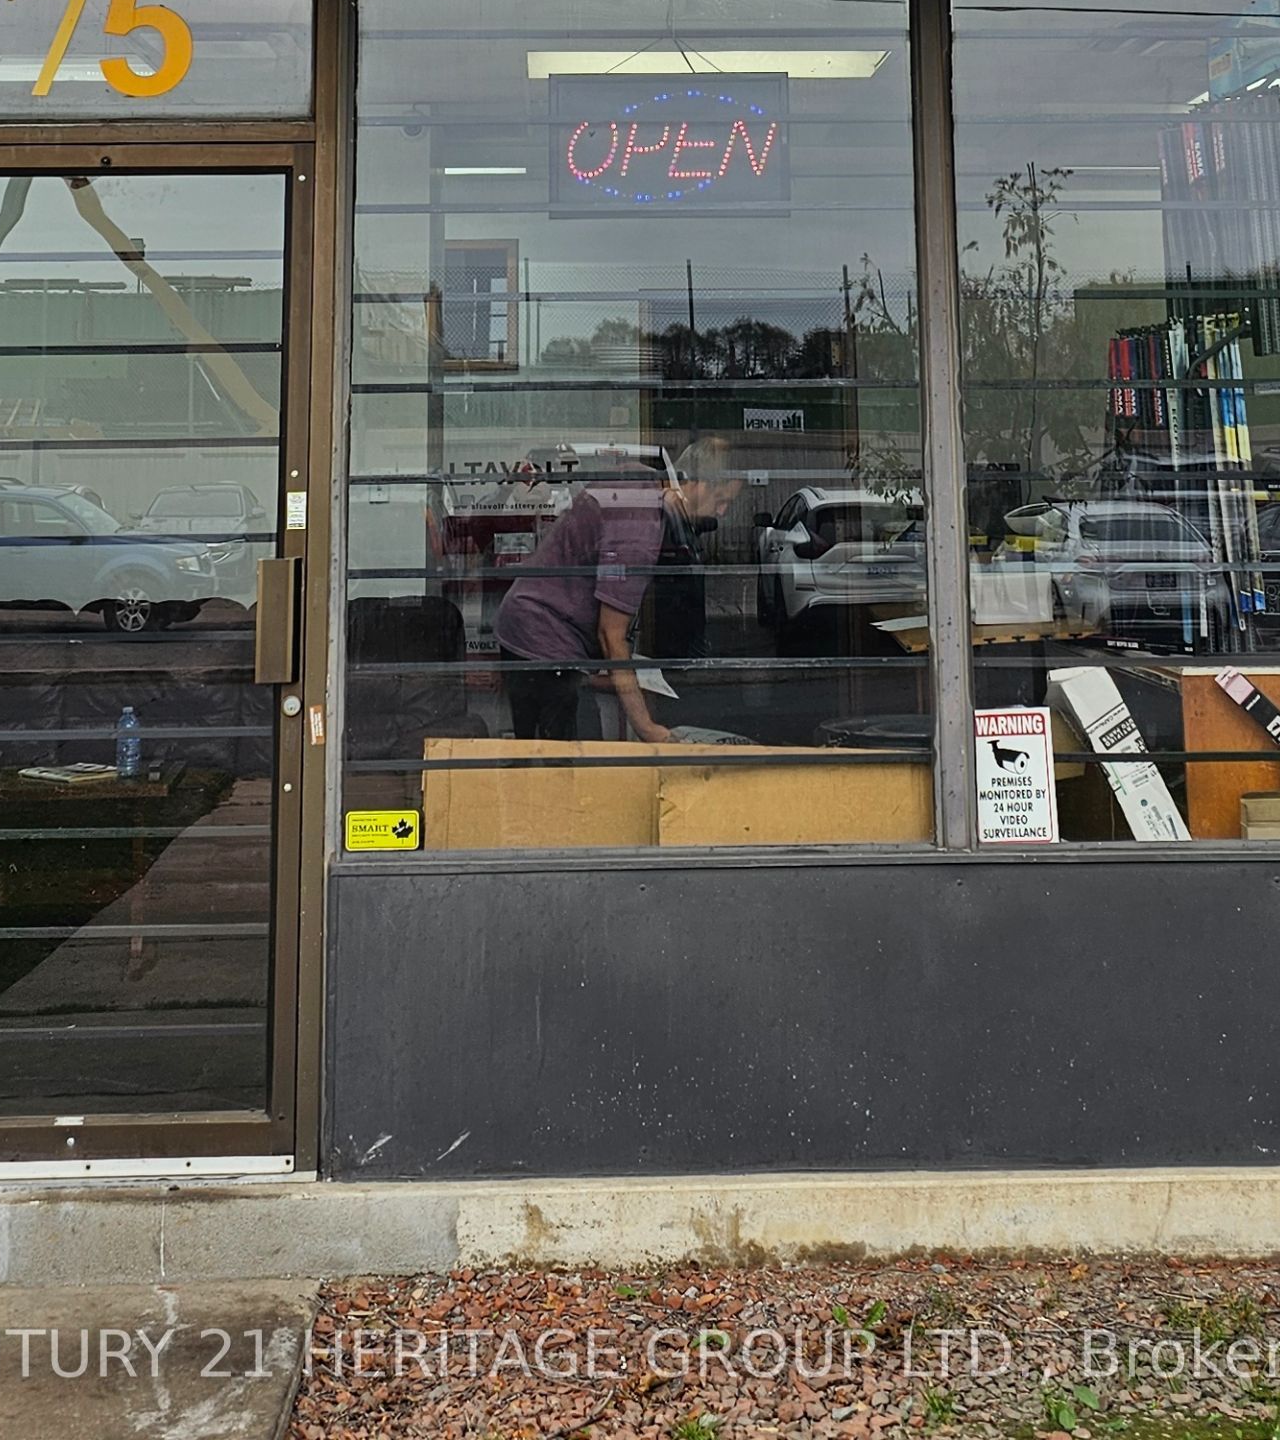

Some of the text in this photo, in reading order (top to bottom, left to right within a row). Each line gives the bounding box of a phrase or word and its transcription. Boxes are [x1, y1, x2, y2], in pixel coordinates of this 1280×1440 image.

[567, 120, 778, 179] OPEN
[448, 461, 579, 489] LTAVOLT
[976, 714, 1044, 736] WARNING
[991, 776, 1033, 788] PREMISES
[979, 789, 1047, 801] MONITORED BY
[993, 802, 1034, 813] 24 HOUR
[1000, 814, 1029, 826] VIDEO
[351, 824, 390, 833] SMART
[983, 827, 1048, 840] SURVEILLANCE
